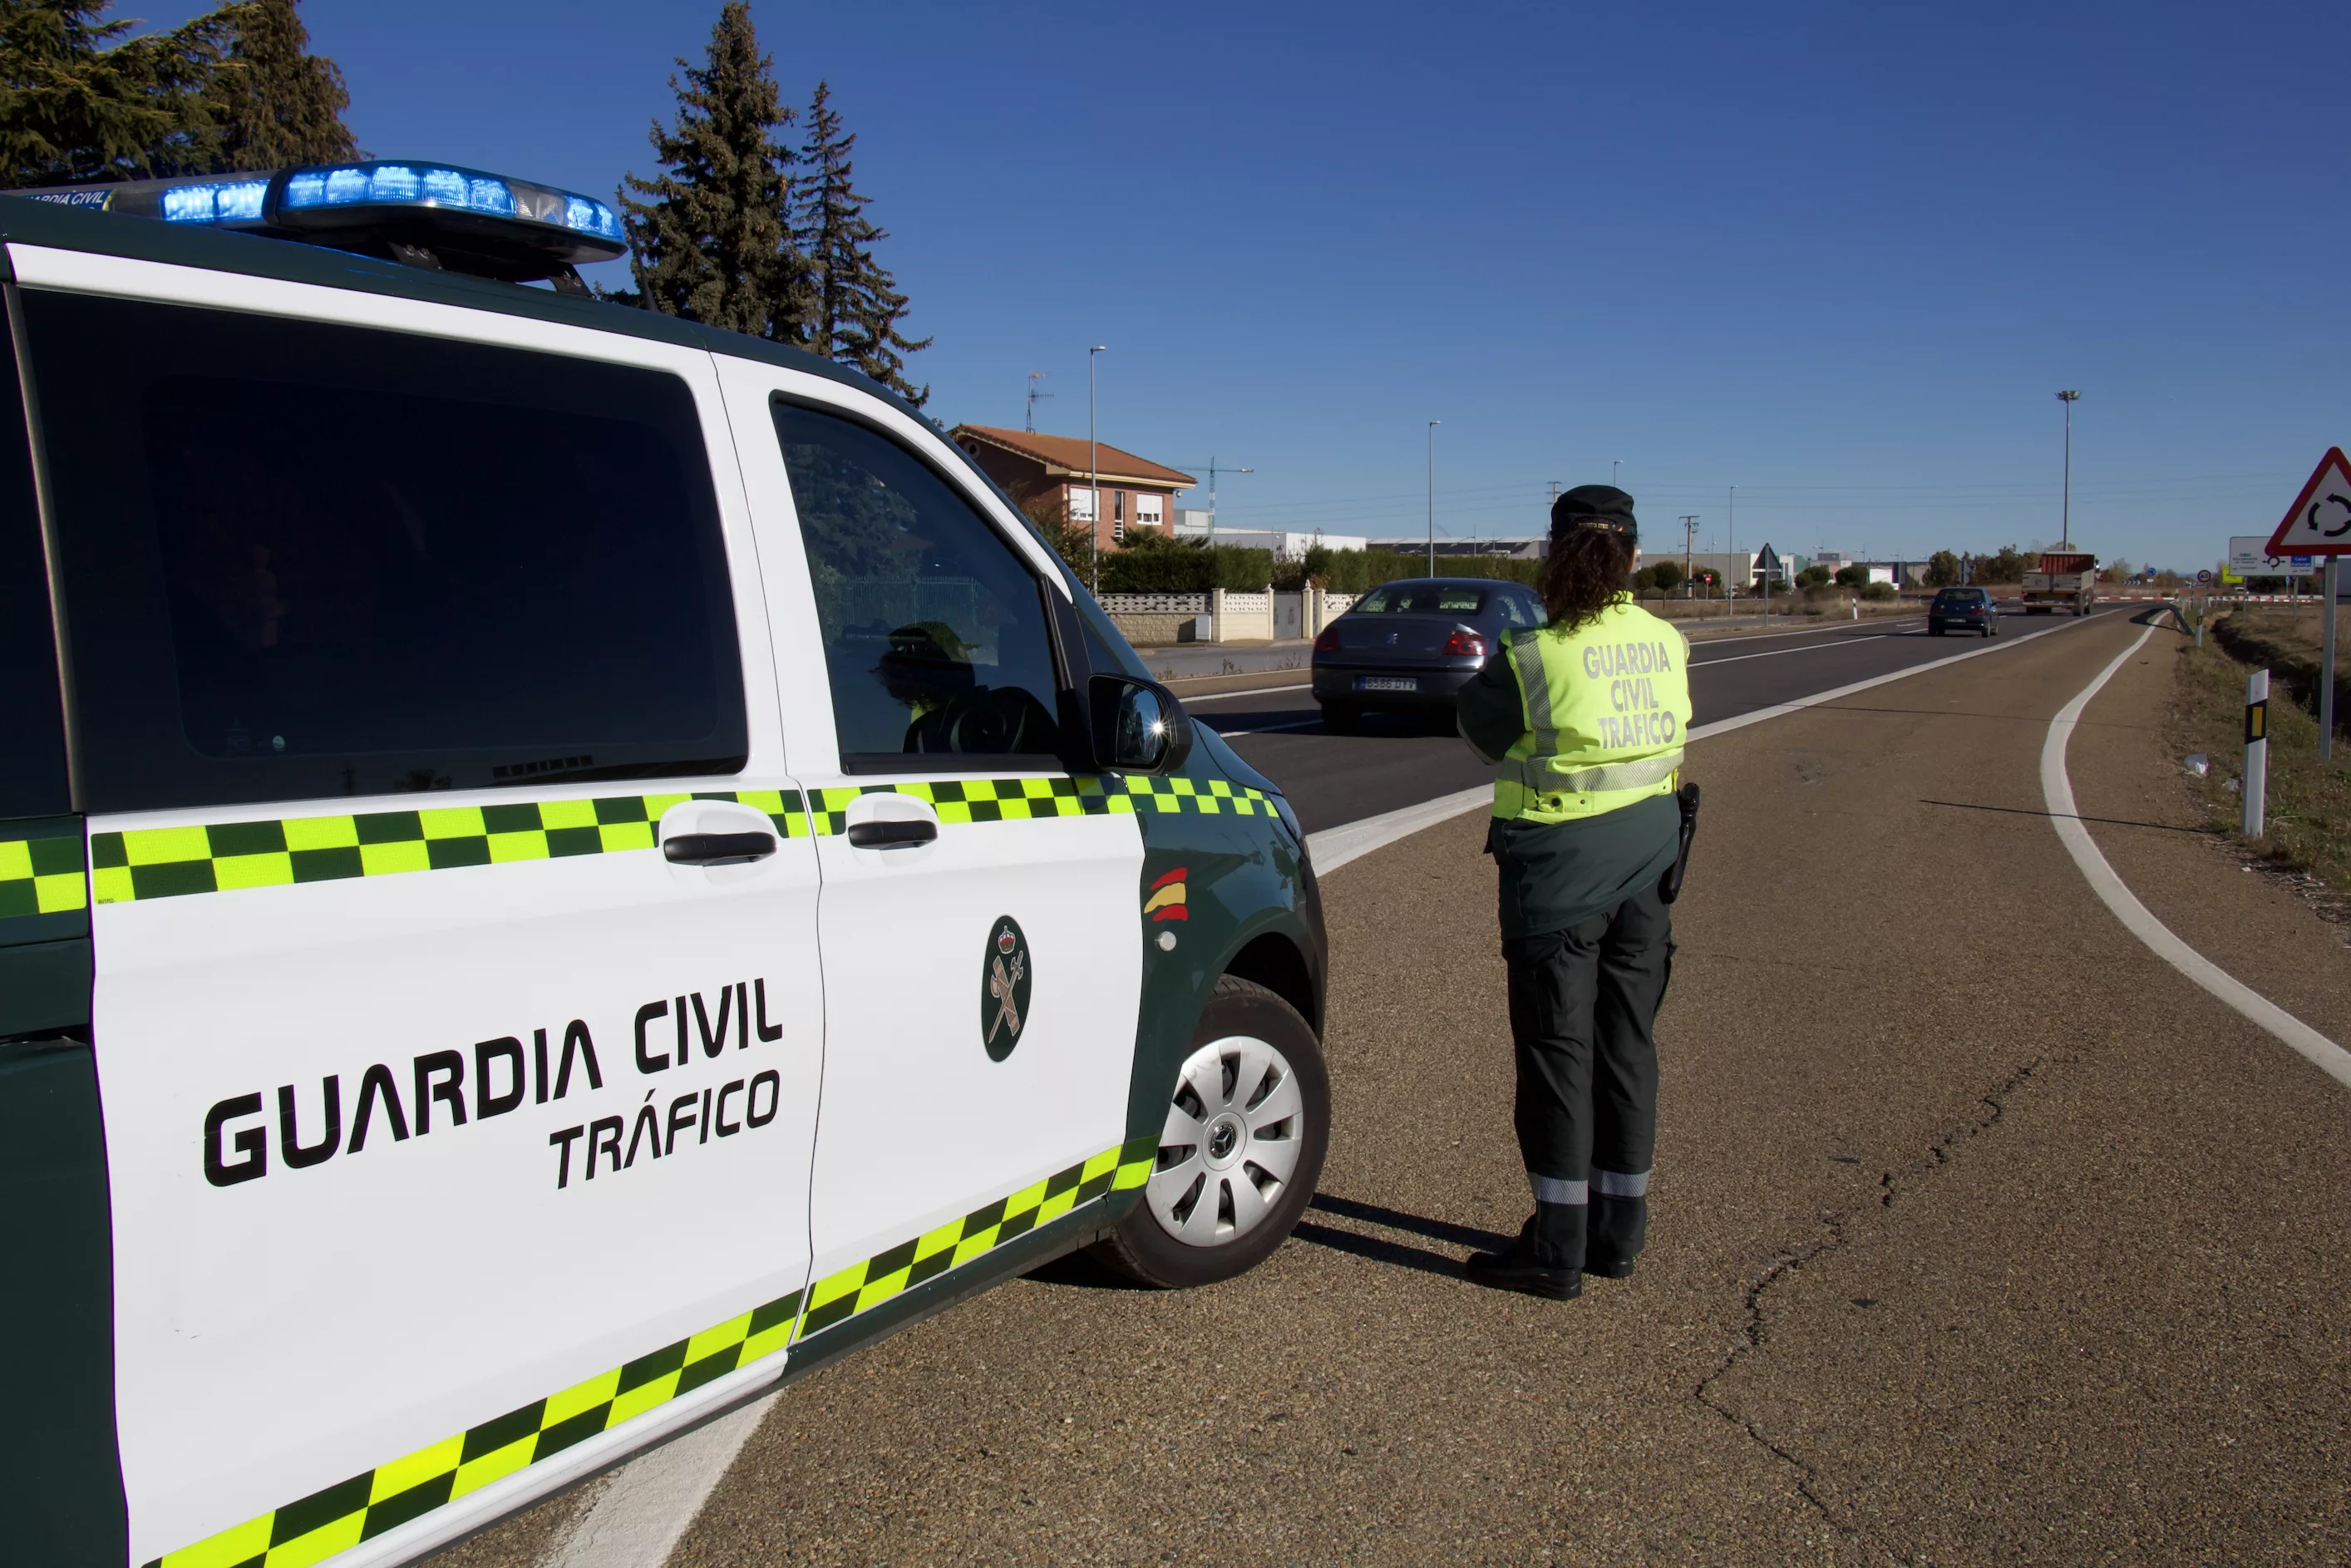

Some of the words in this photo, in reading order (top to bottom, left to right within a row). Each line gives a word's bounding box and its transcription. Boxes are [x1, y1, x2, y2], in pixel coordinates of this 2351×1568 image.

[71, 191, 105, 205] CIVIL
[1583, 642, 1672, 679] GUARDIA
[1610, 678, 1659, 713] CIVIL
[1597, 711, 1676, 749] TRAFICO
[204, 1018, 603, 1187] GUARDIA
[634, 978, 782, 1074] CIVIL
[549, 1069, 781, 1189] TRÁFICO
